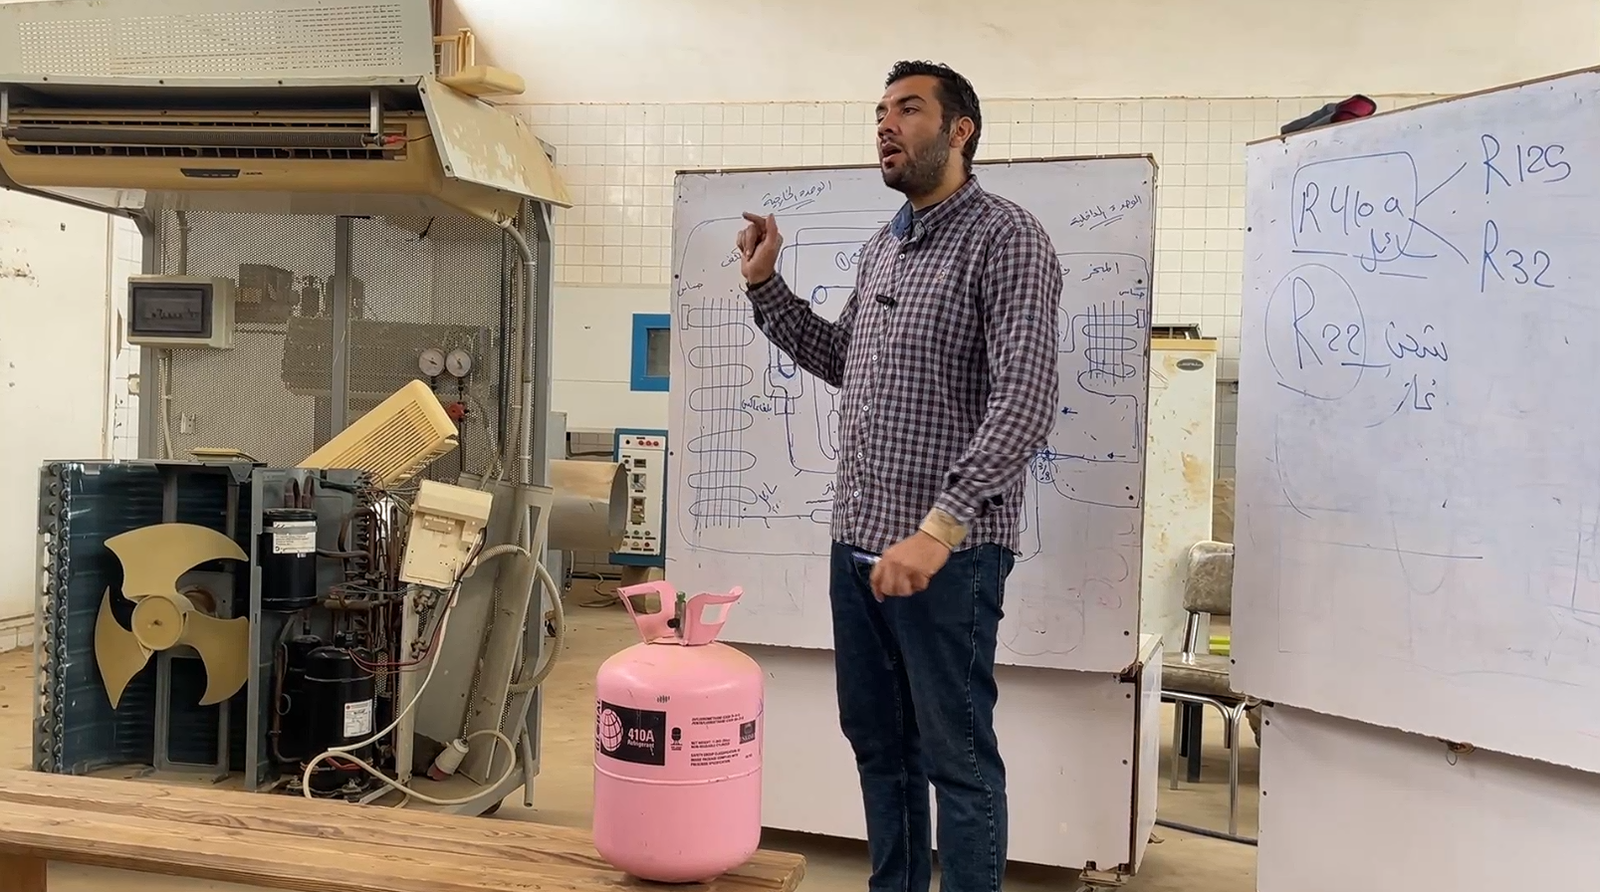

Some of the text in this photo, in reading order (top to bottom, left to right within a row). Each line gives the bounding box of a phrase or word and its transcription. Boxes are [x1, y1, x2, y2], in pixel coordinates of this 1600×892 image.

[1481, 220, 1555, 292] R32
[1293, 276, 1360, 369] R22
[627, 727, 655, 743] 410A
[627, 738, 655, 749] Refrigerant
